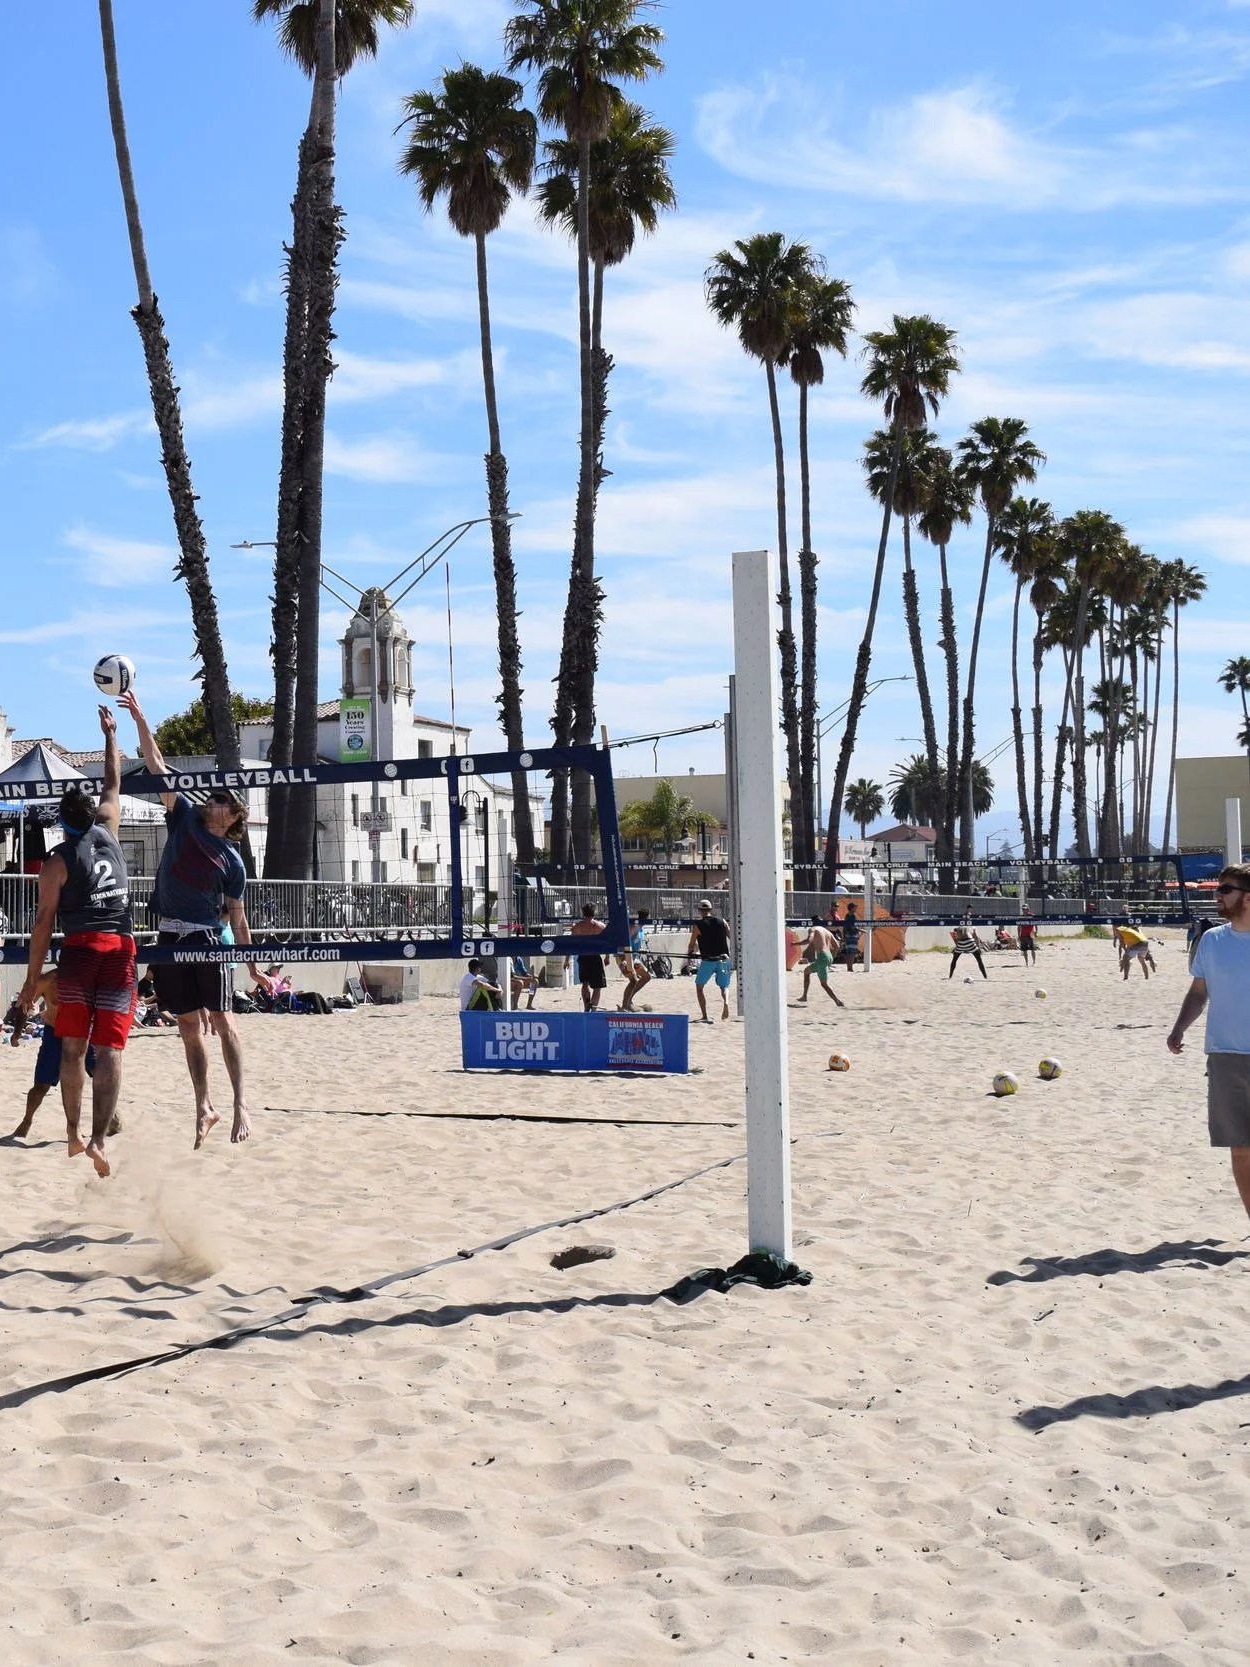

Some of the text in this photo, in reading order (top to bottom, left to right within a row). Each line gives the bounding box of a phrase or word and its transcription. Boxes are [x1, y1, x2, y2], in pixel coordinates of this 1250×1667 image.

[346, 711, 365, 720] 150
[162, 768, 318, 790] VOLLEYBALL
[94, 860, 116, 888] 2
[173, 947, 340, 962] www.santacruzwharf.com
[495, 1022, 550, 1041] BUD
[485, 1041, 559, 1061] LIGHT
